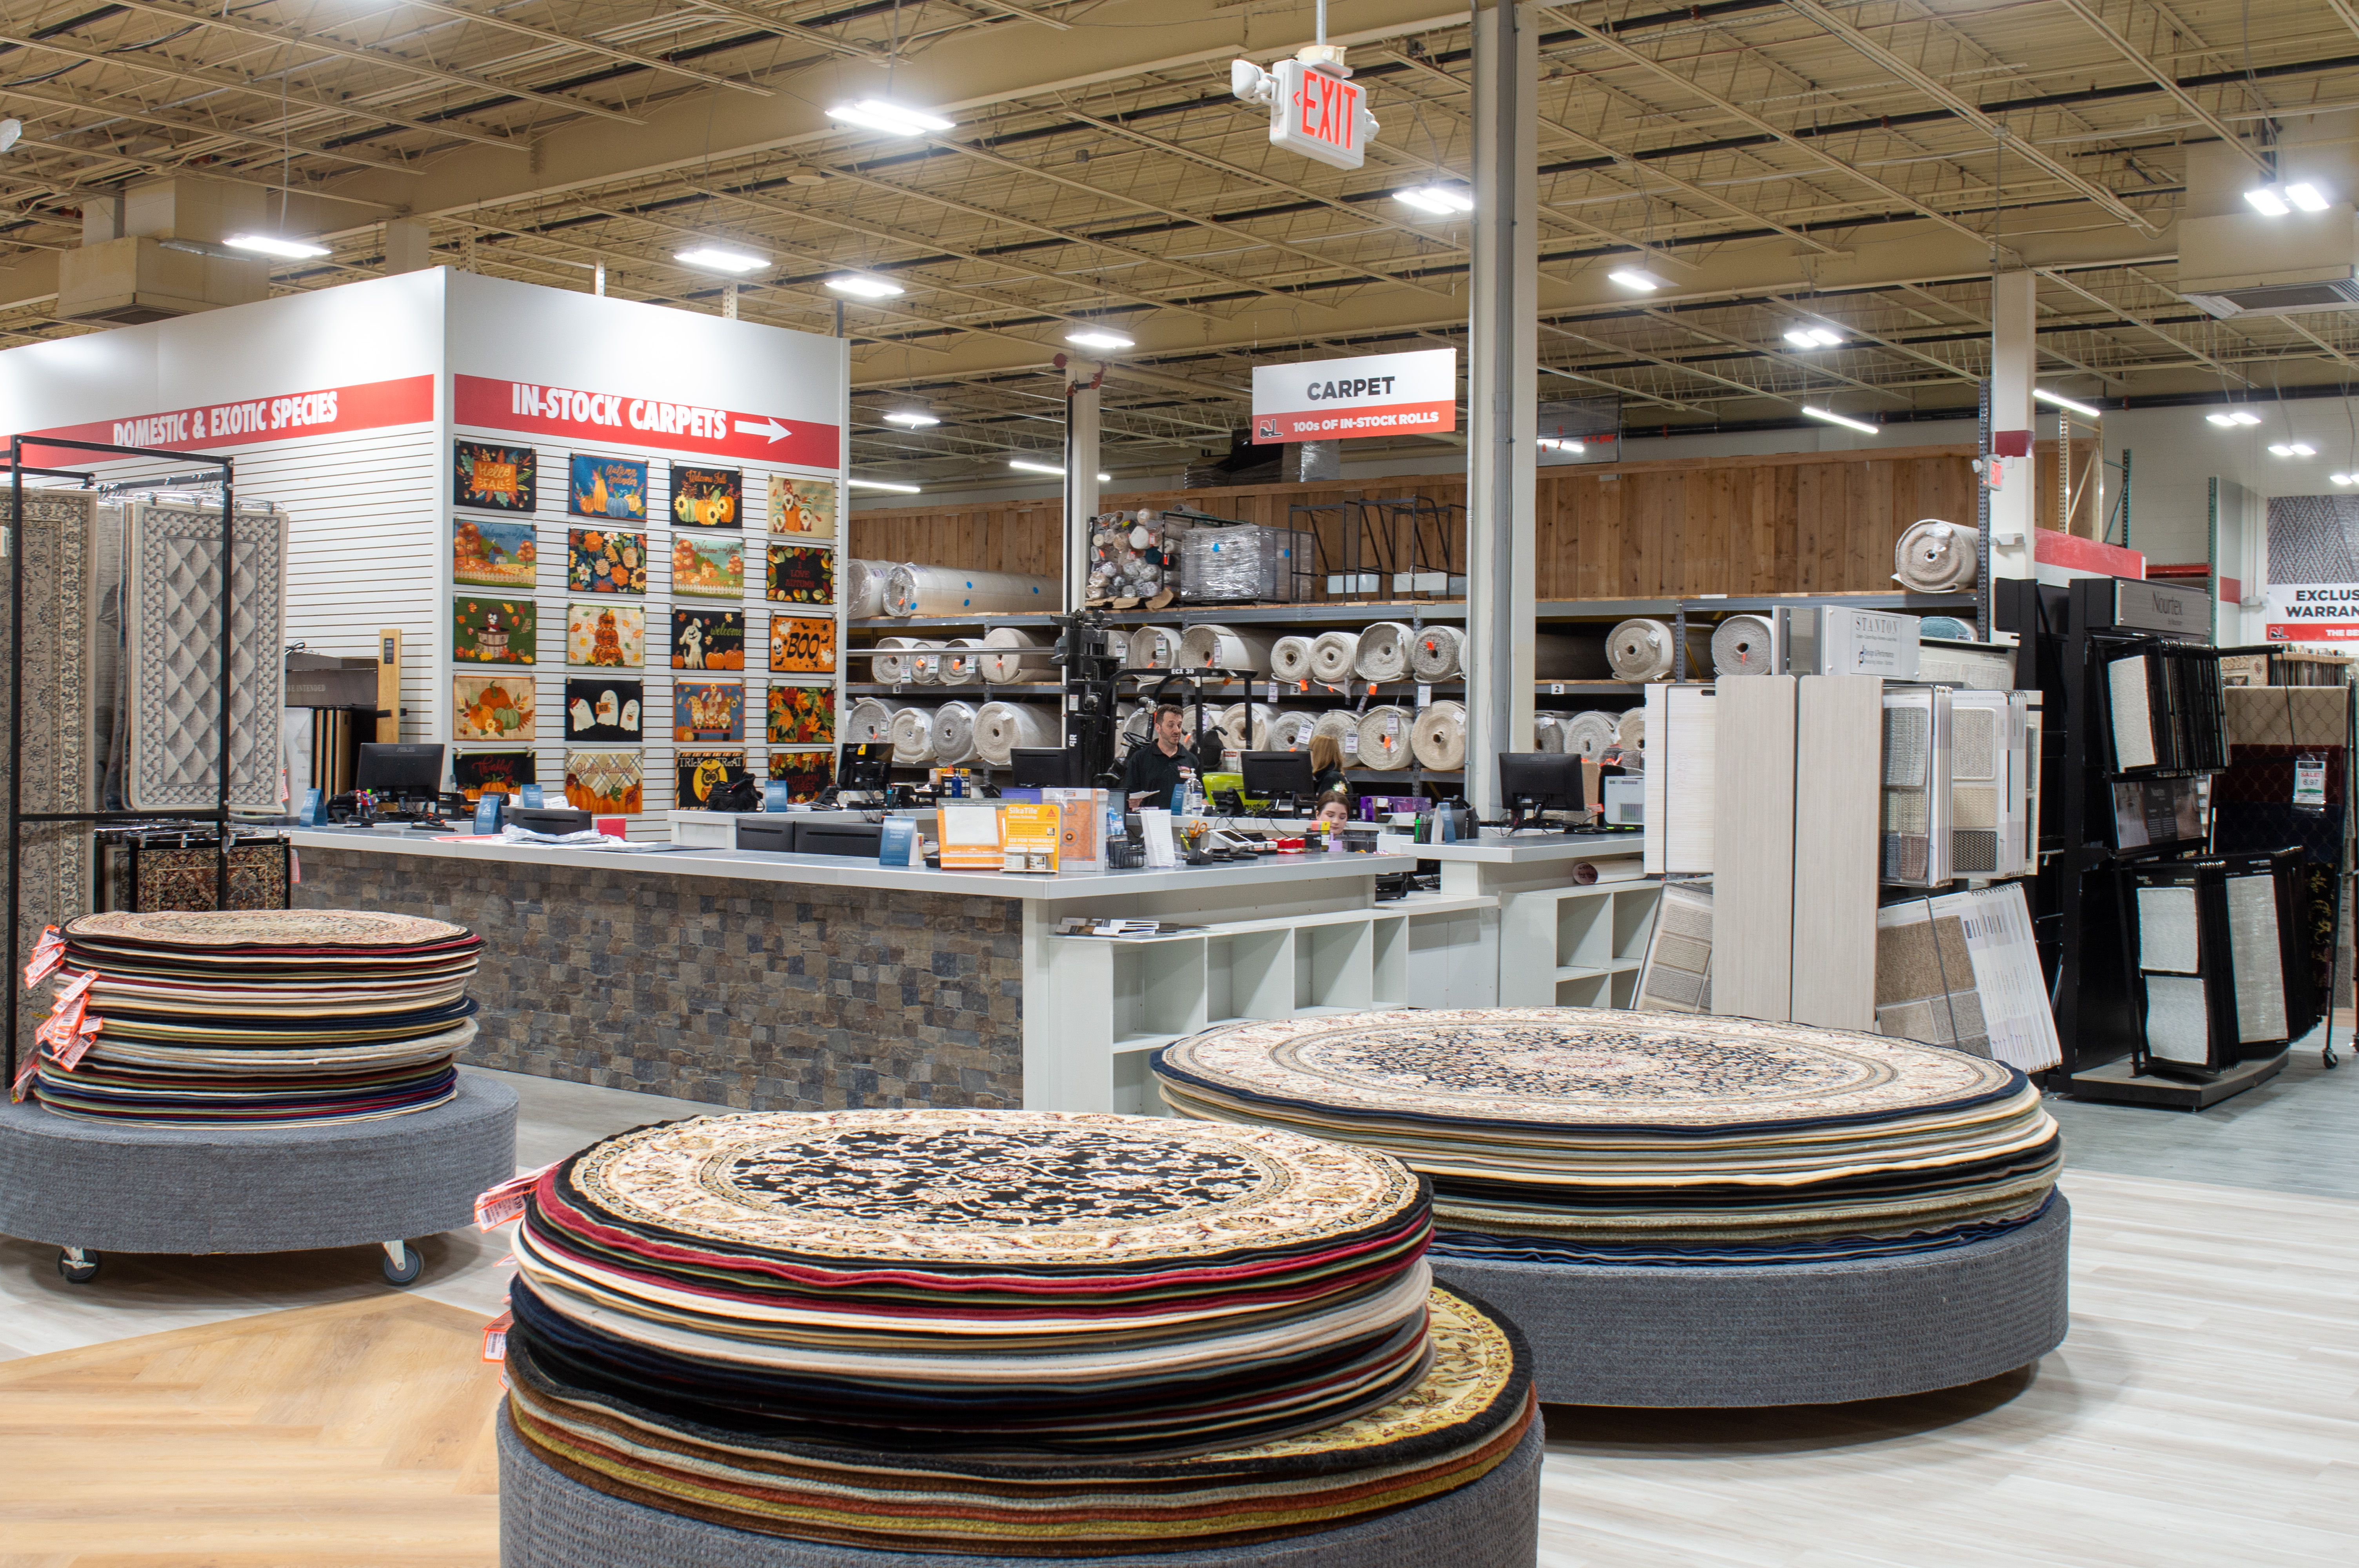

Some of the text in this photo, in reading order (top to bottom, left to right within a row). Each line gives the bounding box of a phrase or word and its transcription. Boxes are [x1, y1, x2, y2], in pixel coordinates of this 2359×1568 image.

[1301, 70, 1358, 149] EXIT
[1307, 376, 1395, 400] CARPET
[113, 391, 337, 446] DOMESTIC & EXOTIC SPECIES
[512, 383, 727, 439] IN-STOCK CARPETS
[1293, 412, 1439, 432] 100s OF IN-STOCK ROLLS
[478, 463, 511, 478] Hello
[685, 470, 727, 484] Welcome Fall
[483, 479, 505, 490] FALL
[791, 569, 809, 578] LOVE
[710, 622, 743, 636] welcome
[1856, 617, 1898, 634] STANTON
[786, 632, 820, 659] BOO
